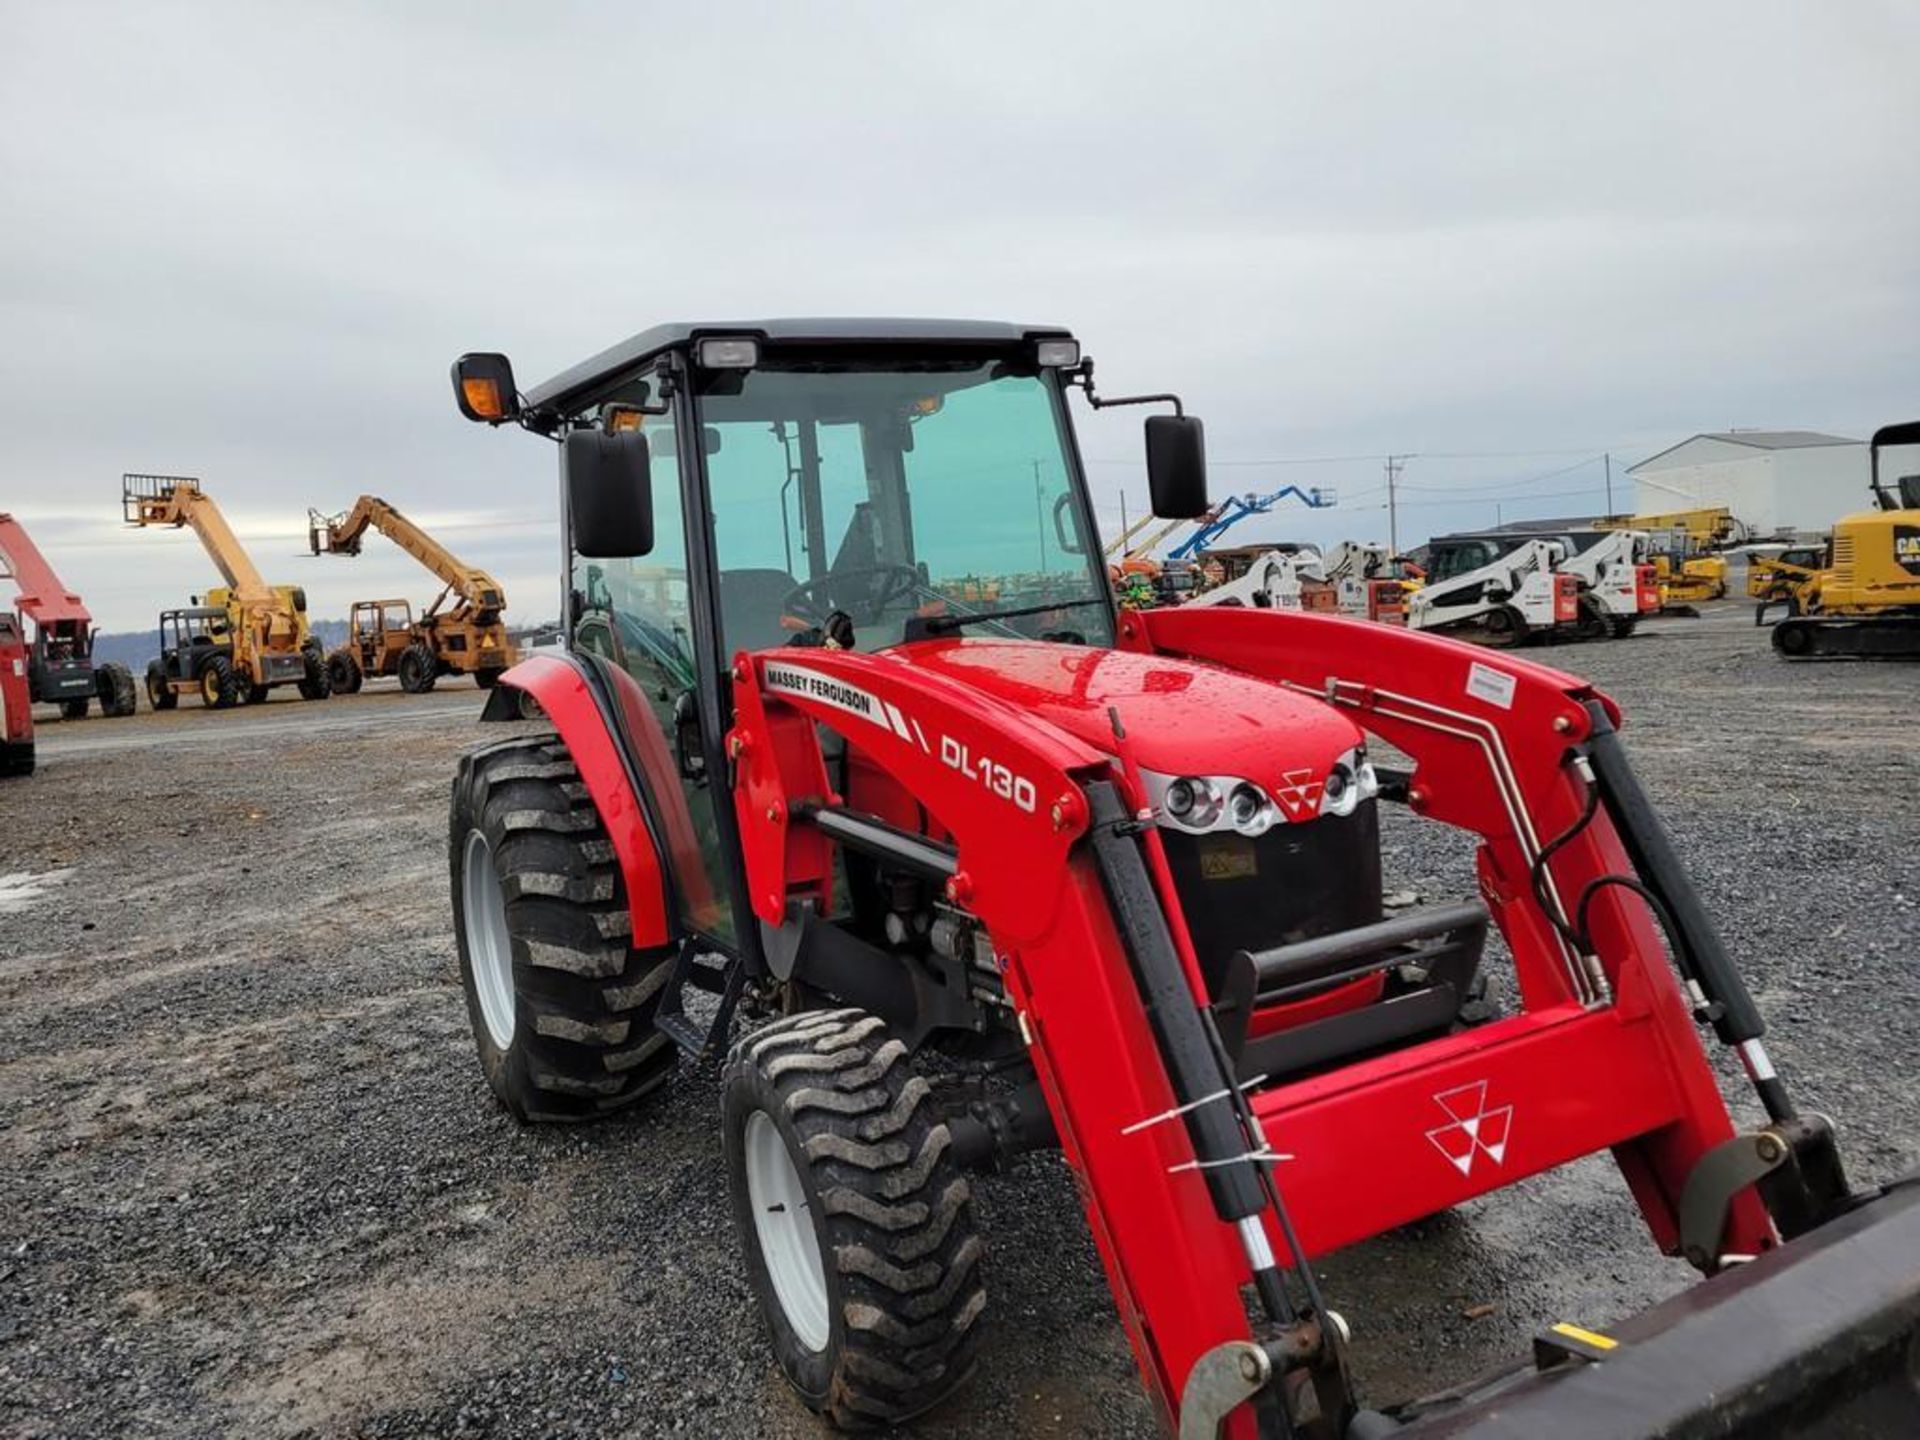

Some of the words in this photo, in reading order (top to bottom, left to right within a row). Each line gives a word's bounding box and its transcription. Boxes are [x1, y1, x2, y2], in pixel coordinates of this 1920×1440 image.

[768, 670, 808, 691] MASSEY
[811, 678, 870, 714] FERGUSON
[942, 734, 1036, 813] DL130
